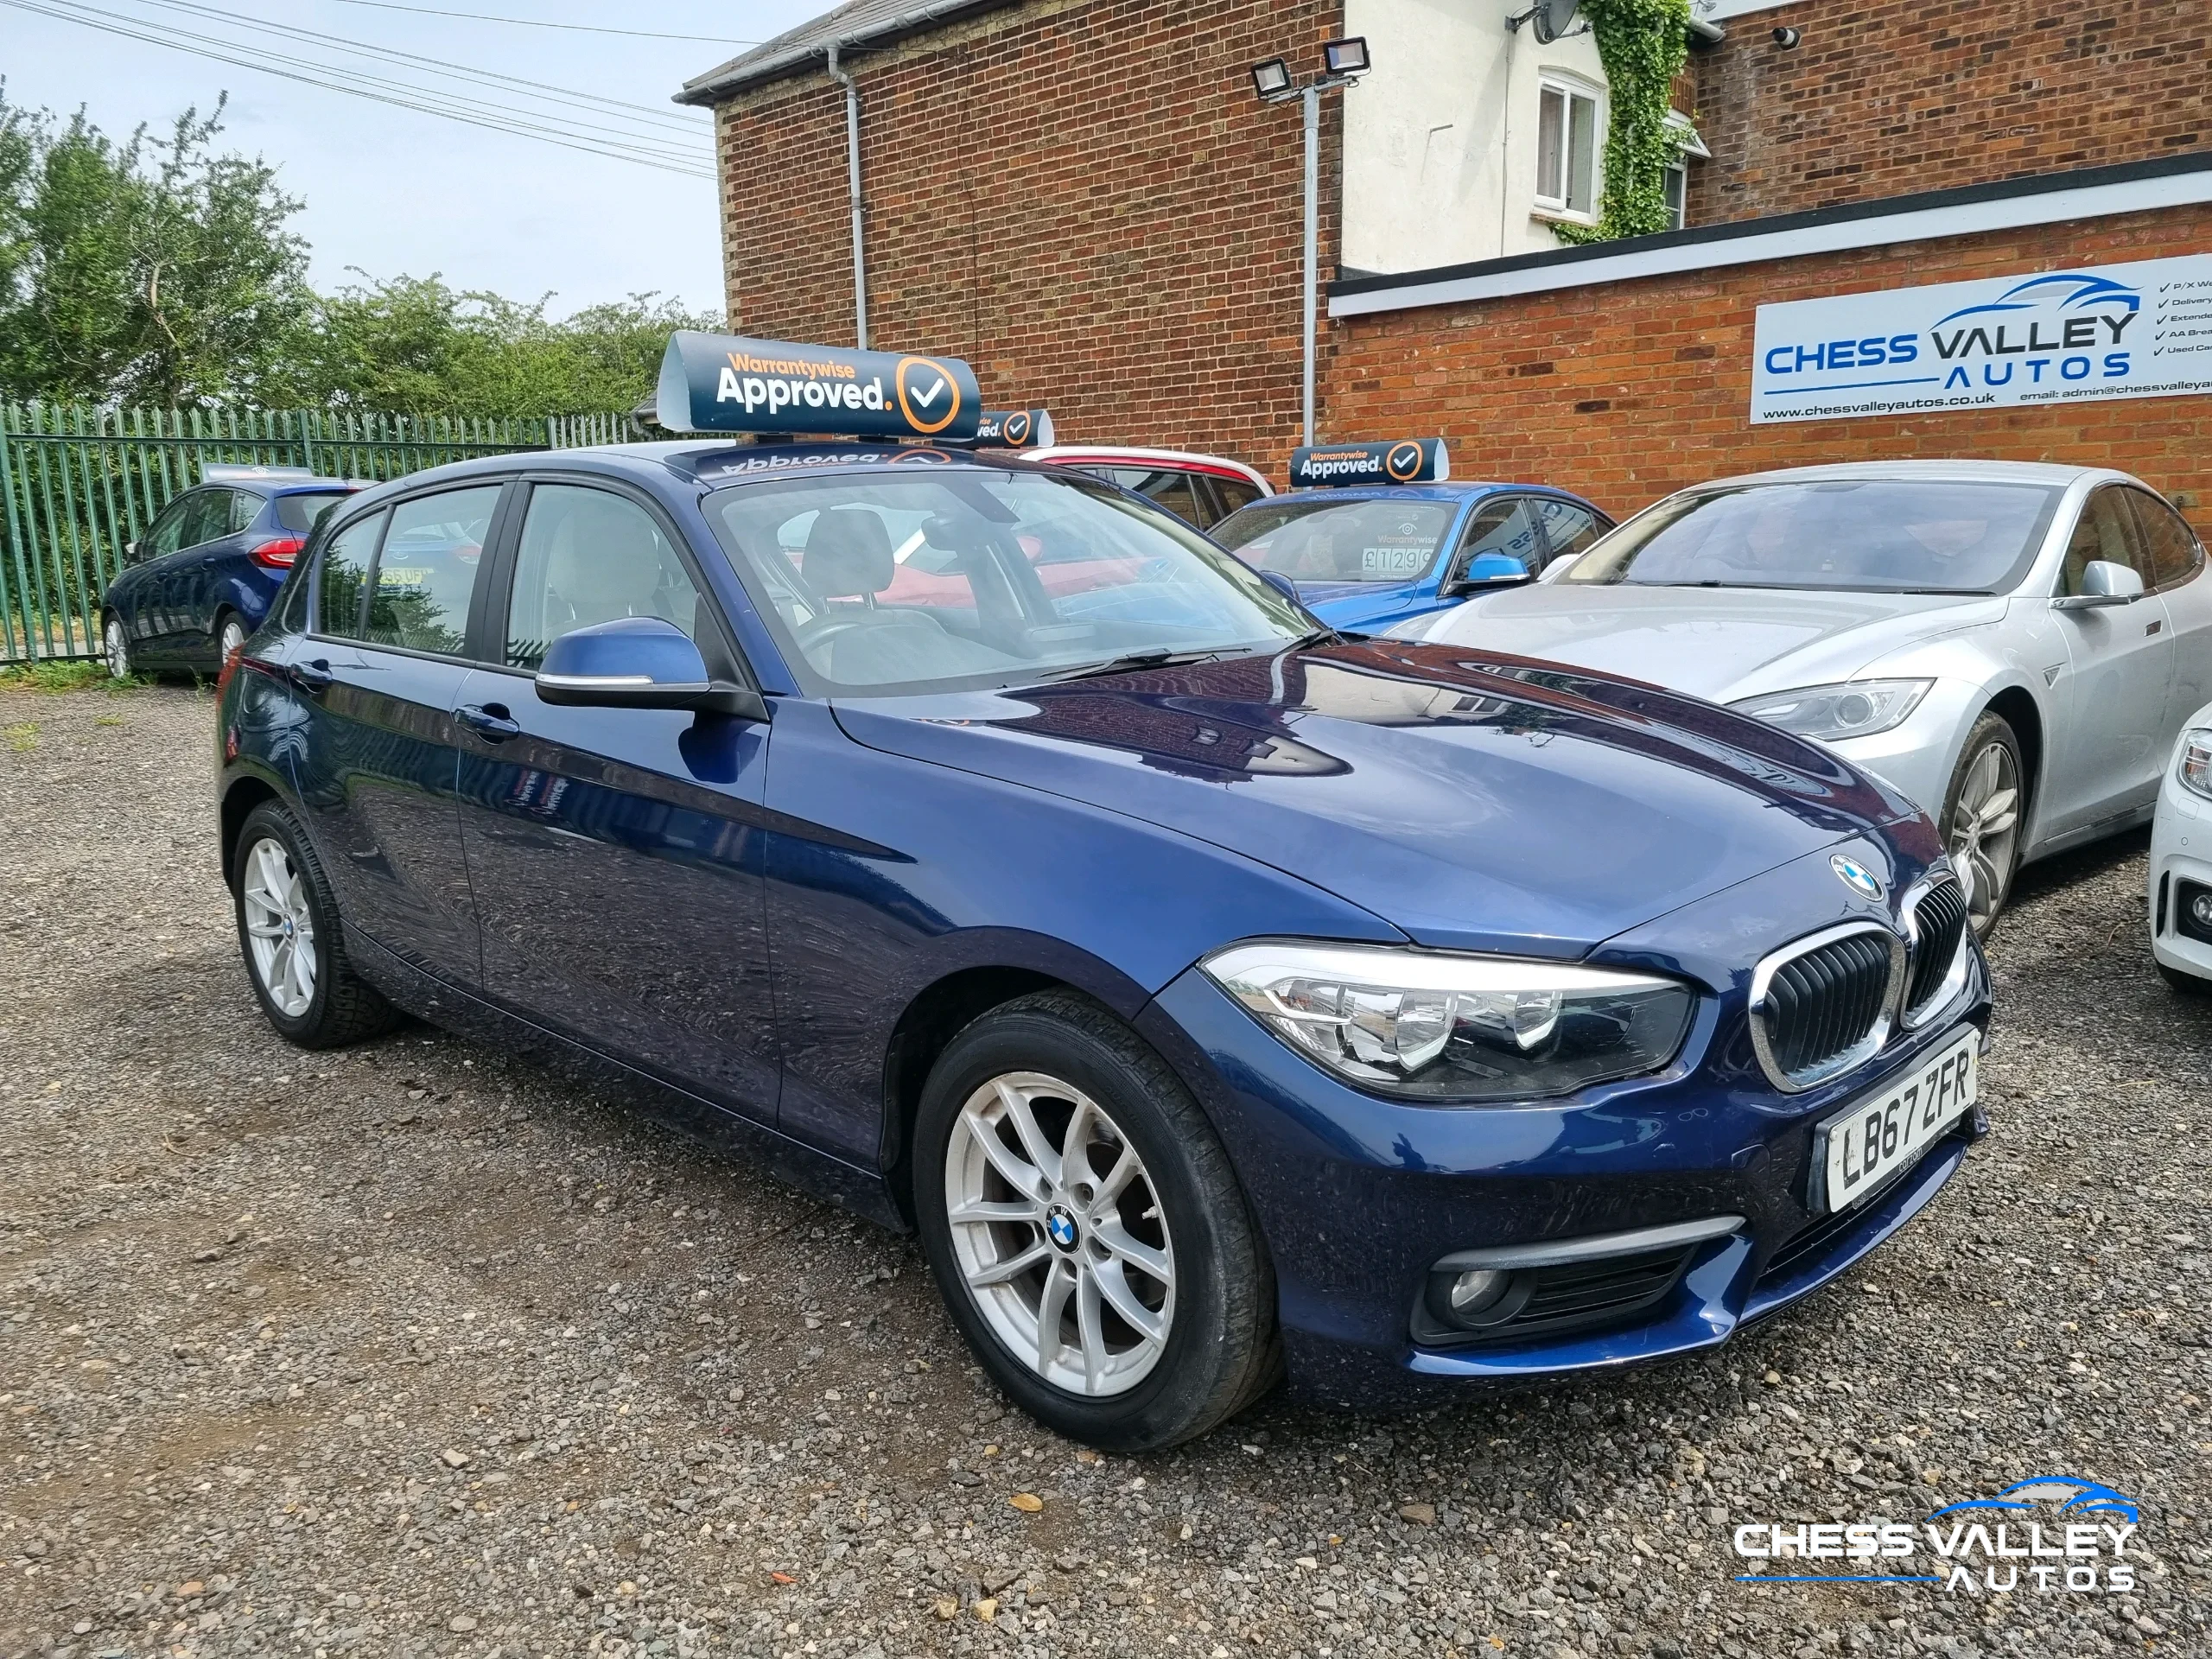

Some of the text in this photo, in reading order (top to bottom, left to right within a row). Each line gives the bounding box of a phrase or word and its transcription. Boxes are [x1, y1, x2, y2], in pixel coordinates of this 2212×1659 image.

[2173, 282, 2196, 290] P/X
[2171, 297, 2212, 306] Delivery
[1765, 313, 2138, 374] CHESS VALLEY
[727, 353, 855, 379] Warrantywise
[1944, 353, 2131, 390] AUTOS
[716, 366, 893, 415] Approved.
[2019, 380, 2212, 401] email: admin@chessvalleya
[1763, 392, 1997, 419] www.chessvalleyautos.co.uk
[1300, 455, 1383, 480] Approved.
[1310, 450, 1369, 461] Warrantywise
[1377, 535, 1438, 545] Warrantywise
[1842, 1047, 1969, 1191] LB67 ZFR
[1046, 1206, 1068, 1229] BMW
